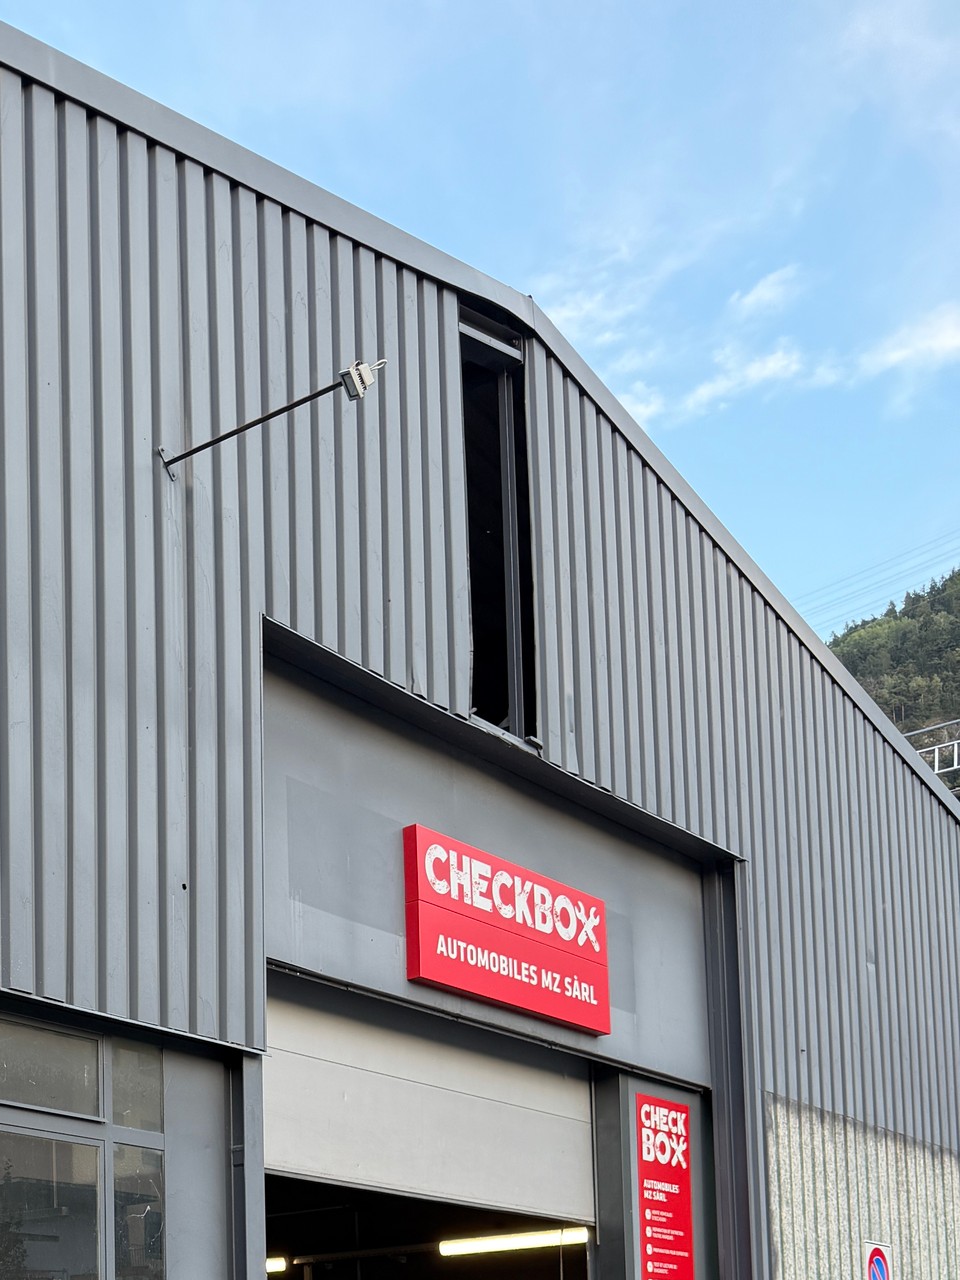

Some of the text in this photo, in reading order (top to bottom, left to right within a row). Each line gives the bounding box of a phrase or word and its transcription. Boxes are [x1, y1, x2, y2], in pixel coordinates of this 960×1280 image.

[424, 843, 601, 953] CHECKBOX
[436, 934, 598, 1005] AUTOMOBILES MZ SÀRL
[640, 1103, 687, 1136] CHECK
[641, 1127, 688, 1170] BOX
[643, 1178, 680, 1194] AUTOMOBILES
